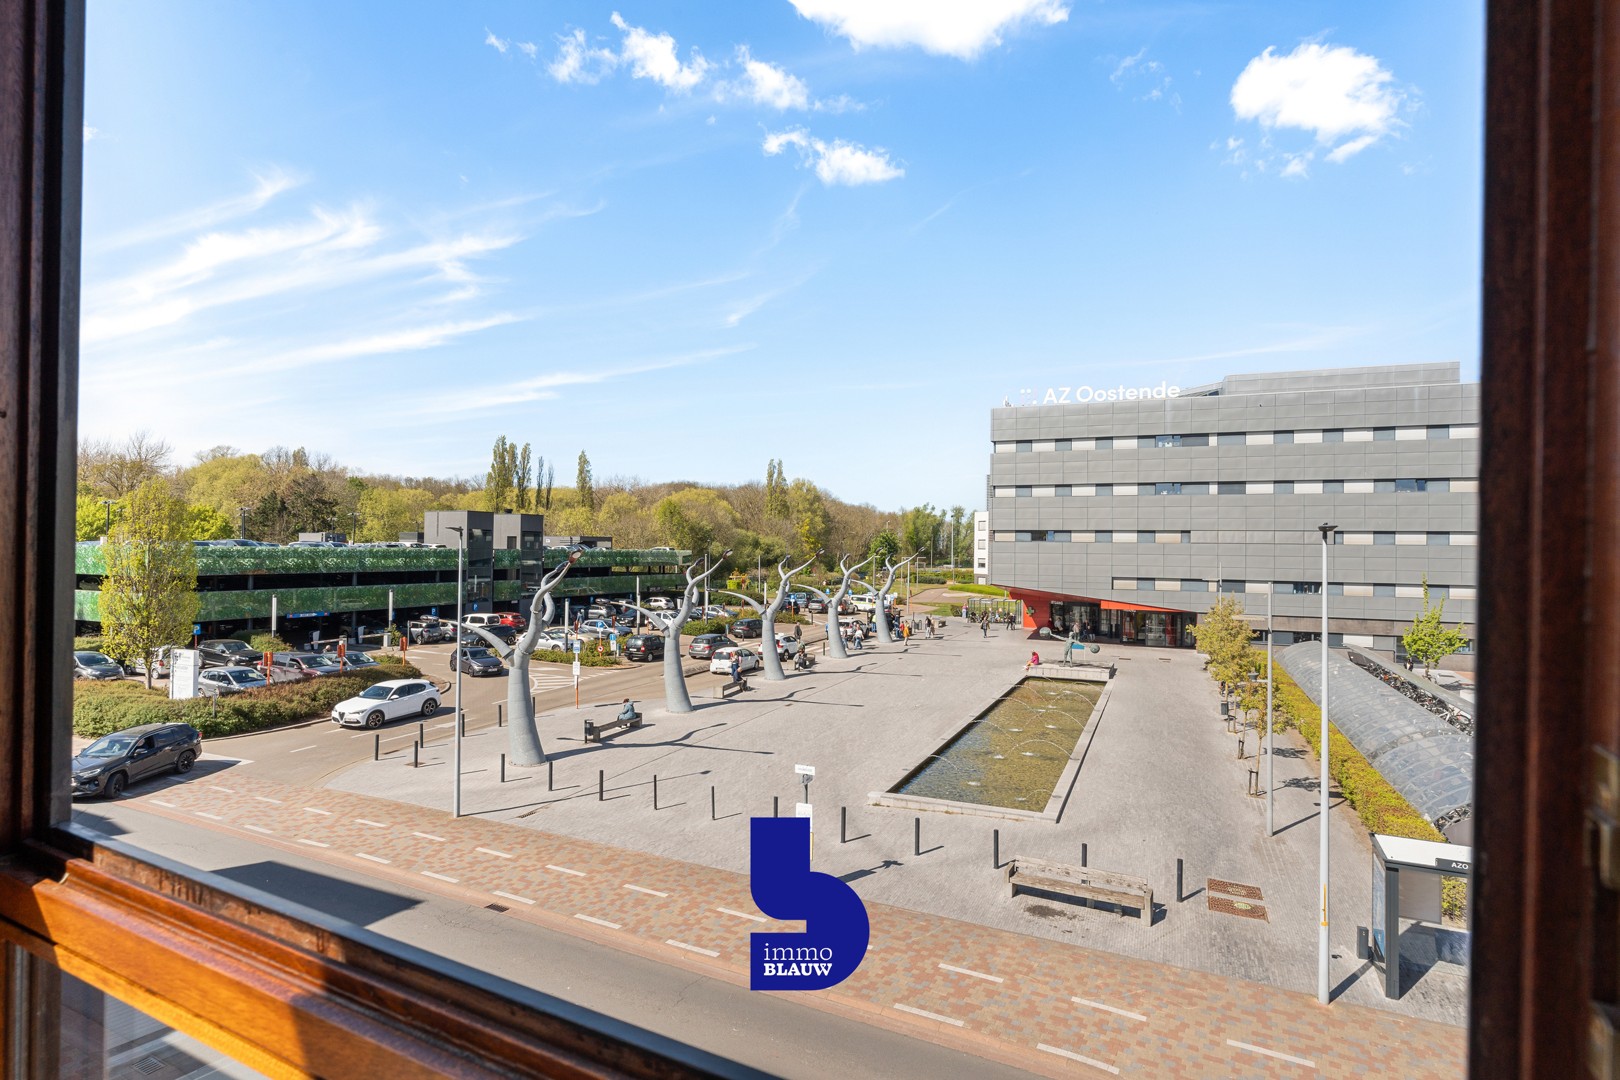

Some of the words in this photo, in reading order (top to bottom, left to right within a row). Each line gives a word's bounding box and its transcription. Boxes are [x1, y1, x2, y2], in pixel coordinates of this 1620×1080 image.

[1043, 387, 1071, 404] AZ
[1076, 381, 1180, 402] Oostende
[1451, 862, 1469, 870] AZO
